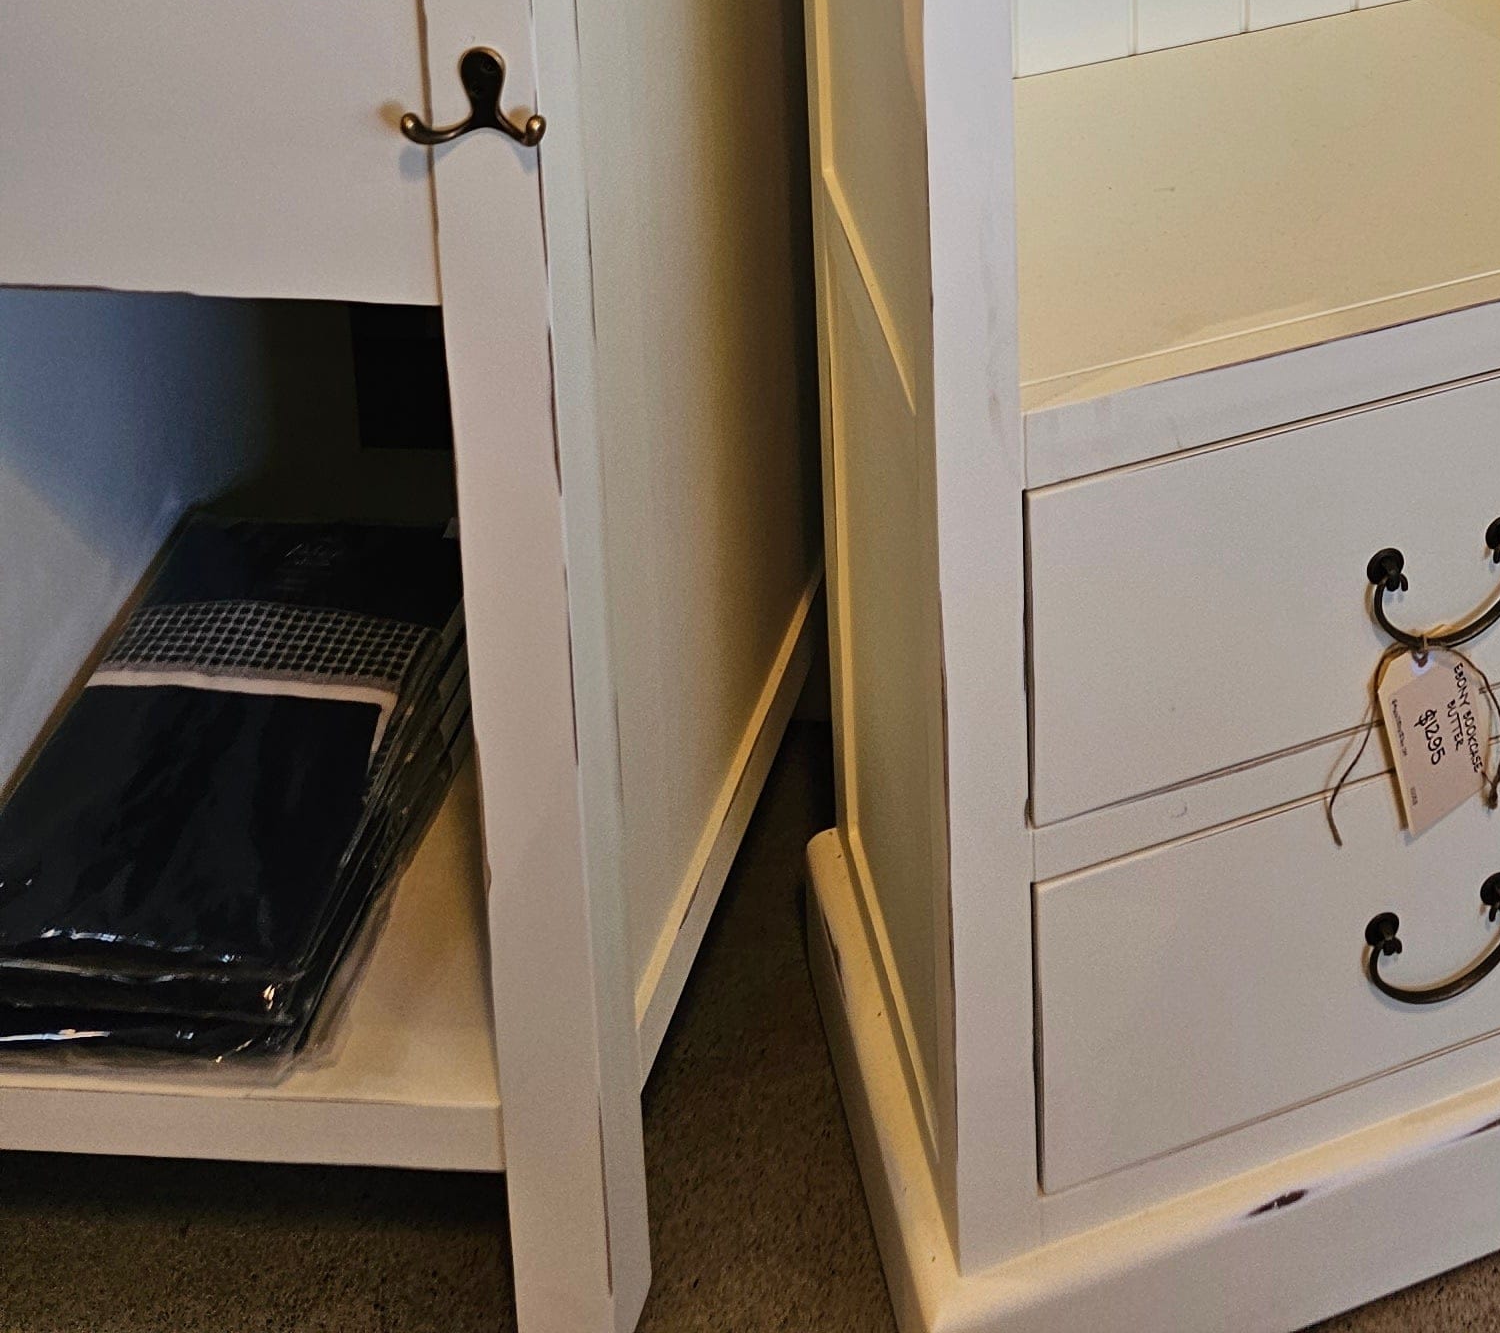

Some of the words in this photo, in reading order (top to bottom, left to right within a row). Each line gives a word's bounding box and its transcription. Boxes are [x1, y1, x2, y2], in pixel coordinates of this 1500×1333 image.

[1413, 709, 1446, 765] $1295
[1446, 698, 1465, 752] BUTTER
[1453, 662, 1470, 707] EBONY
[1462, 710, 1484, 774] BOOKCASE
